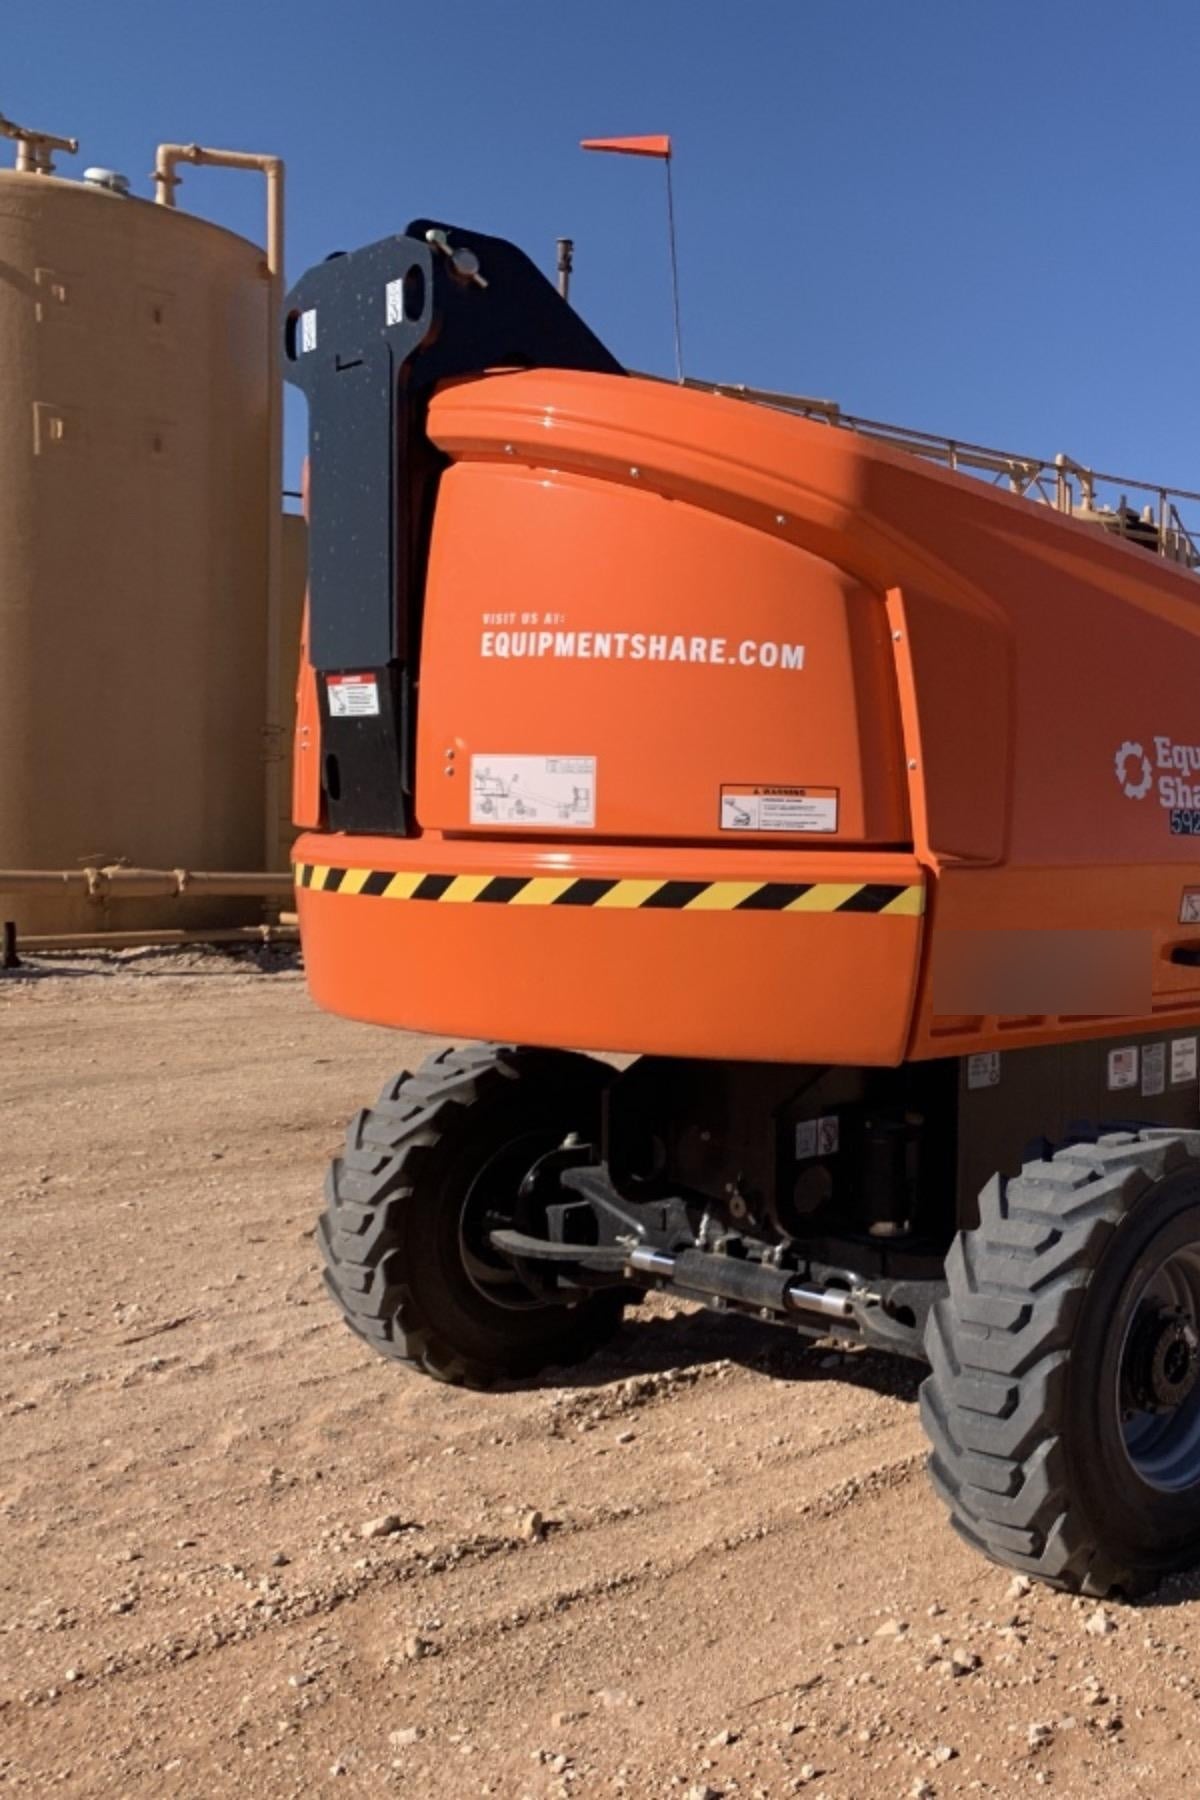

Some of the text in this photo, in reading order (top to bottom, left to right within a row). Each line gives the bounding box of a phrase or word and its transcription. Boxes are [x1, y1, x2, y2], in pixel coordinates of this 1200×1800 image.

[482, 612, 516, 625] VISIT
[521, 612, 539, 625] US
[480, 631, 806, 670] EQUIPMENTSHARE.COM
